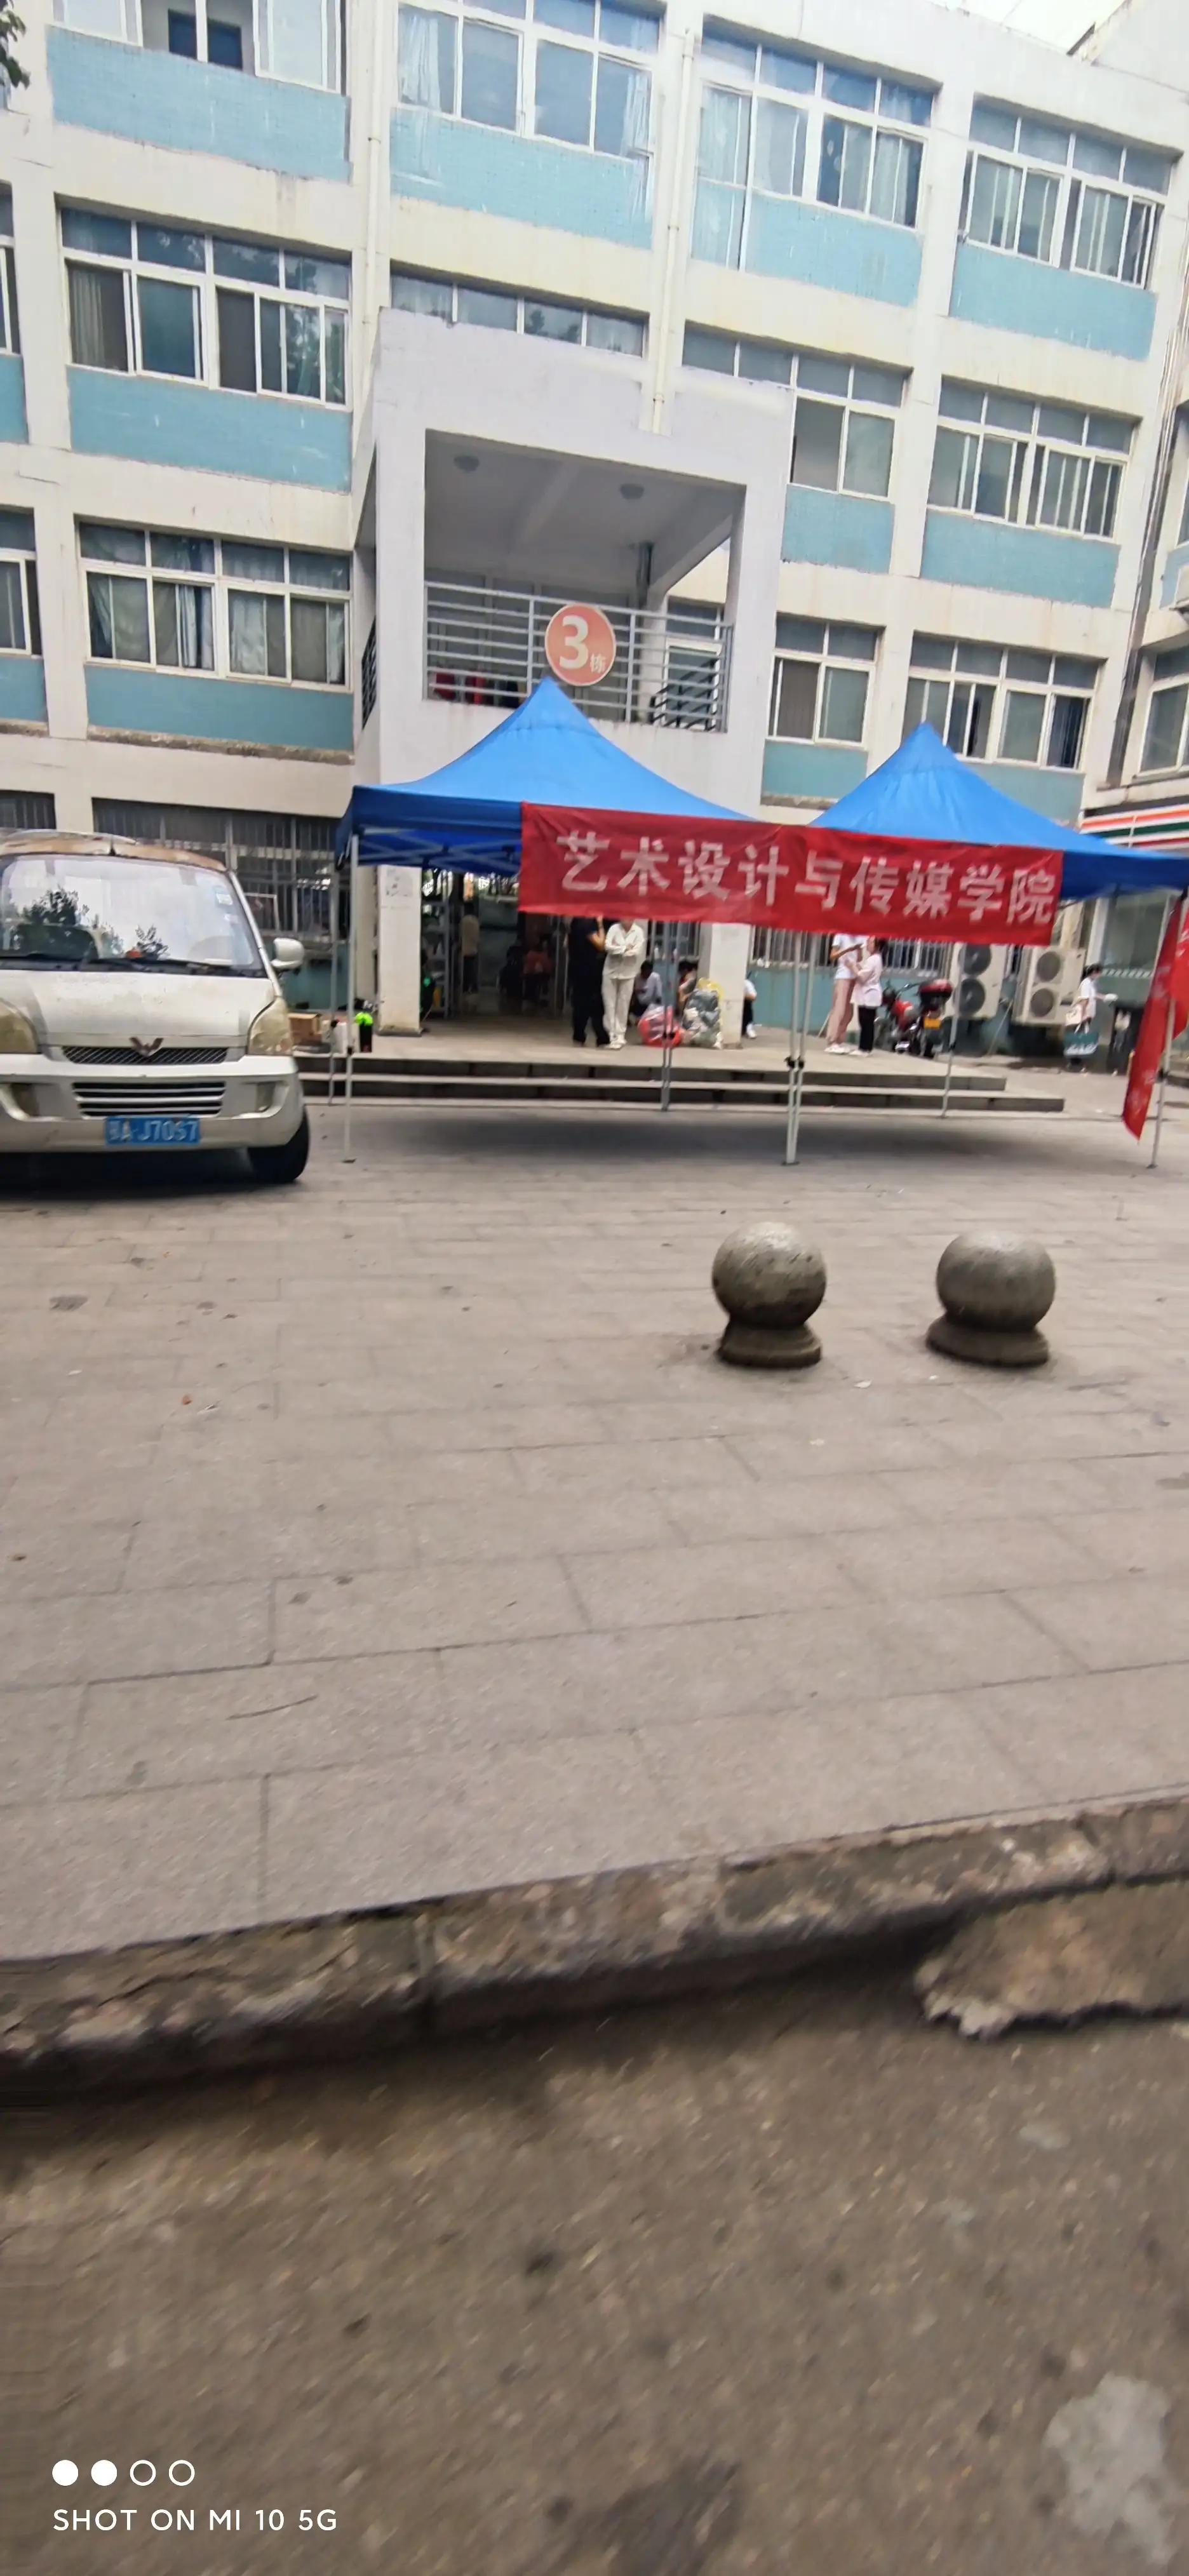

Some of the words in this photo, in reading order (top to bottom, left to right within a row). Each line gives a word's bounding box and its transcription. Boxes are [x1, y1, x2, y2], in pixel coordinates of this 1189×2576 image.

[556, 829, 1056, 925] 艺术设计与传媒学院
